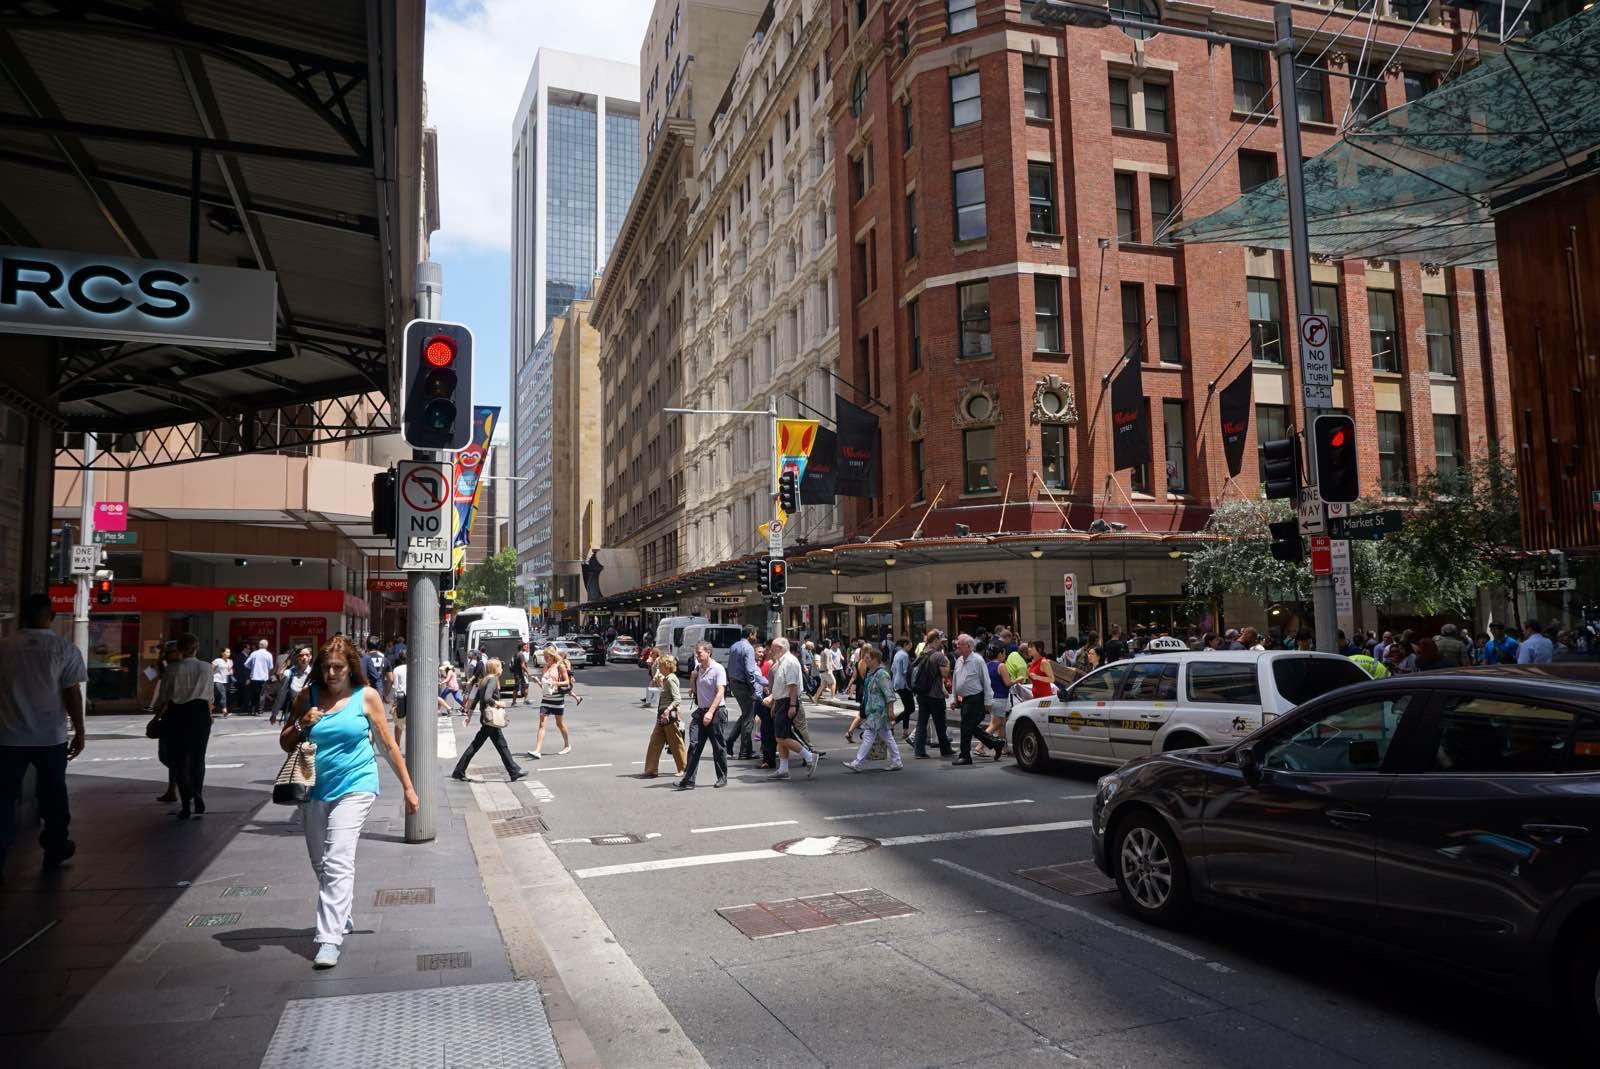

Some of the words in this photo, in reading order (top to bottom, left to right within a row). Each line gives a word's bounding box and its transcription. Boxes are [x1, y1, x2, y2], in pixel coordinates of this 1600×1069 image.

[1, 257, 191, 318] RCS
[1309, 350, 1325, 361] NO
[1307, 363, 1328, 371] RIGHT
[1309, 373, 1329, 381] TURN
[1301, 487, 1318, 503] ONE
[1300, 504, 1320, 517] WAY
[411, 516, 439, 531] NO
[1343, 516, 1374, 529] Market
[1375, 515, 1385, 526] St
[408, 536, 443, 547] LEFT
[405, 552, 444, 564] TURN
[377, 581, 408, 589] st.georg
[956, 581, 1007, 595] HYPE
[112, 594, 137, 602] ranch
[238, 593, 294, 607] st.george
[1160, 640, 1181, 648] TAXI
